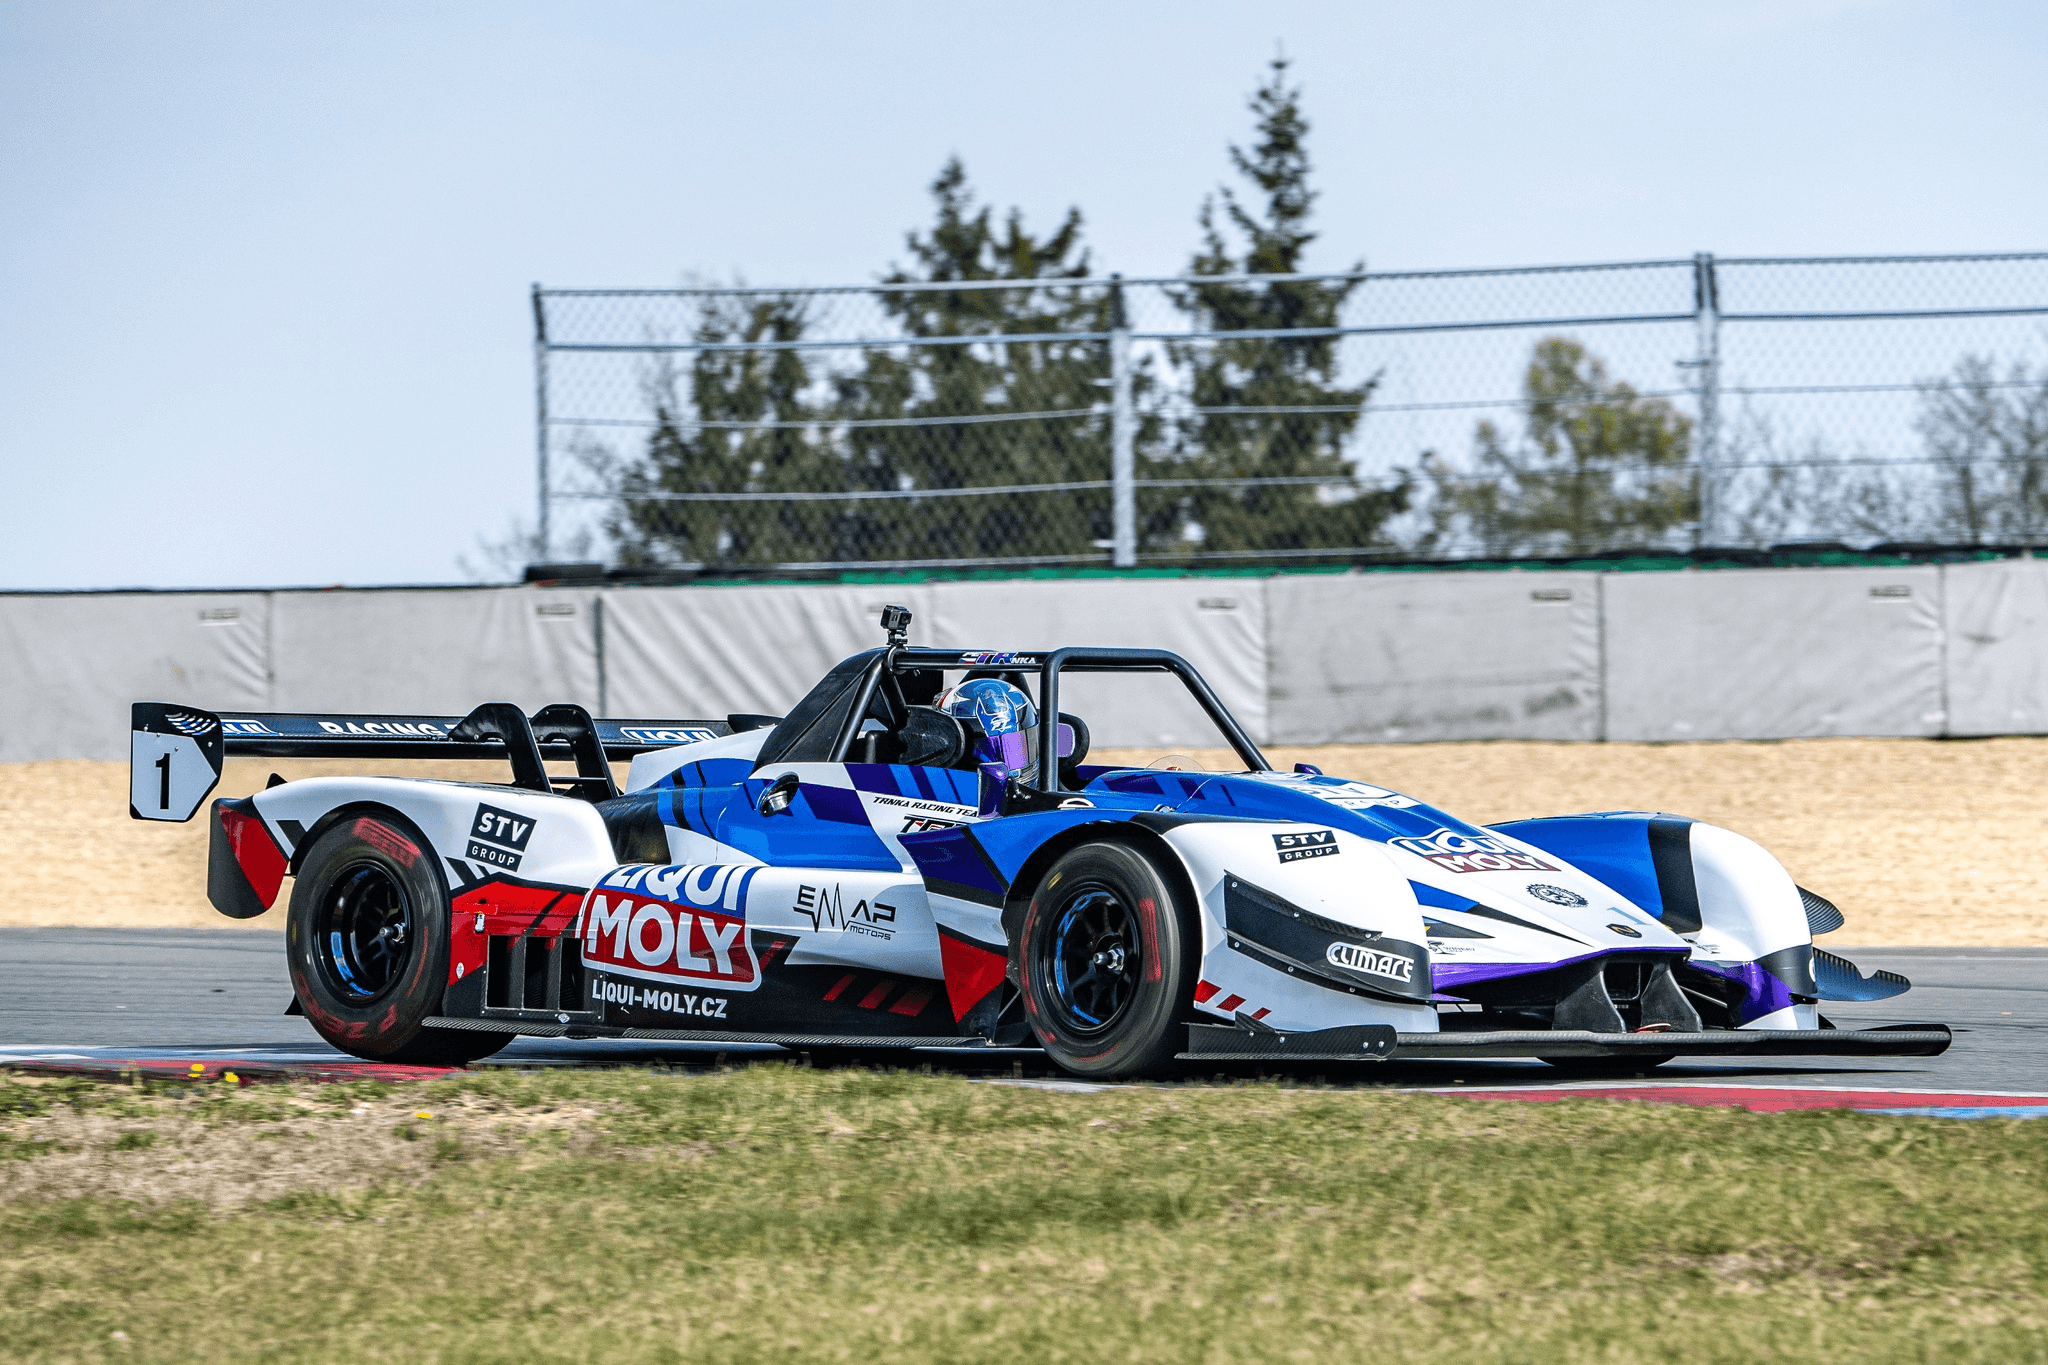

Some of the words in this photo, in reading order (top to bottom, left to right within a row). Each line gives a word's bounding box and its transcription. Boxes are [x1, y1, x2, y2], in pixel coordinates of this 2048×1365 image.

[155, 753, 170, 809] 1
[873, 796, 909, 808] TRNKA
[911, 801, 956, 814] RACING
[478, 812, 528, 843] STV
[1280, 830, 1329, 847] STV
[1283, 846, 1334, 861] GROUP
[1399, 831, 1521, 856] LIQUI
[472, 845, 516, 867] GROUP
[1431, 852, 1549, 873] MOLY
[603, 864, 747, 911] LIQUI
[586, 894, 743, 975] MOLY
[849, 925, 892, 941] MOTORS
[592, 979, 728, 1019] LIQUI-MOLY.CZ
